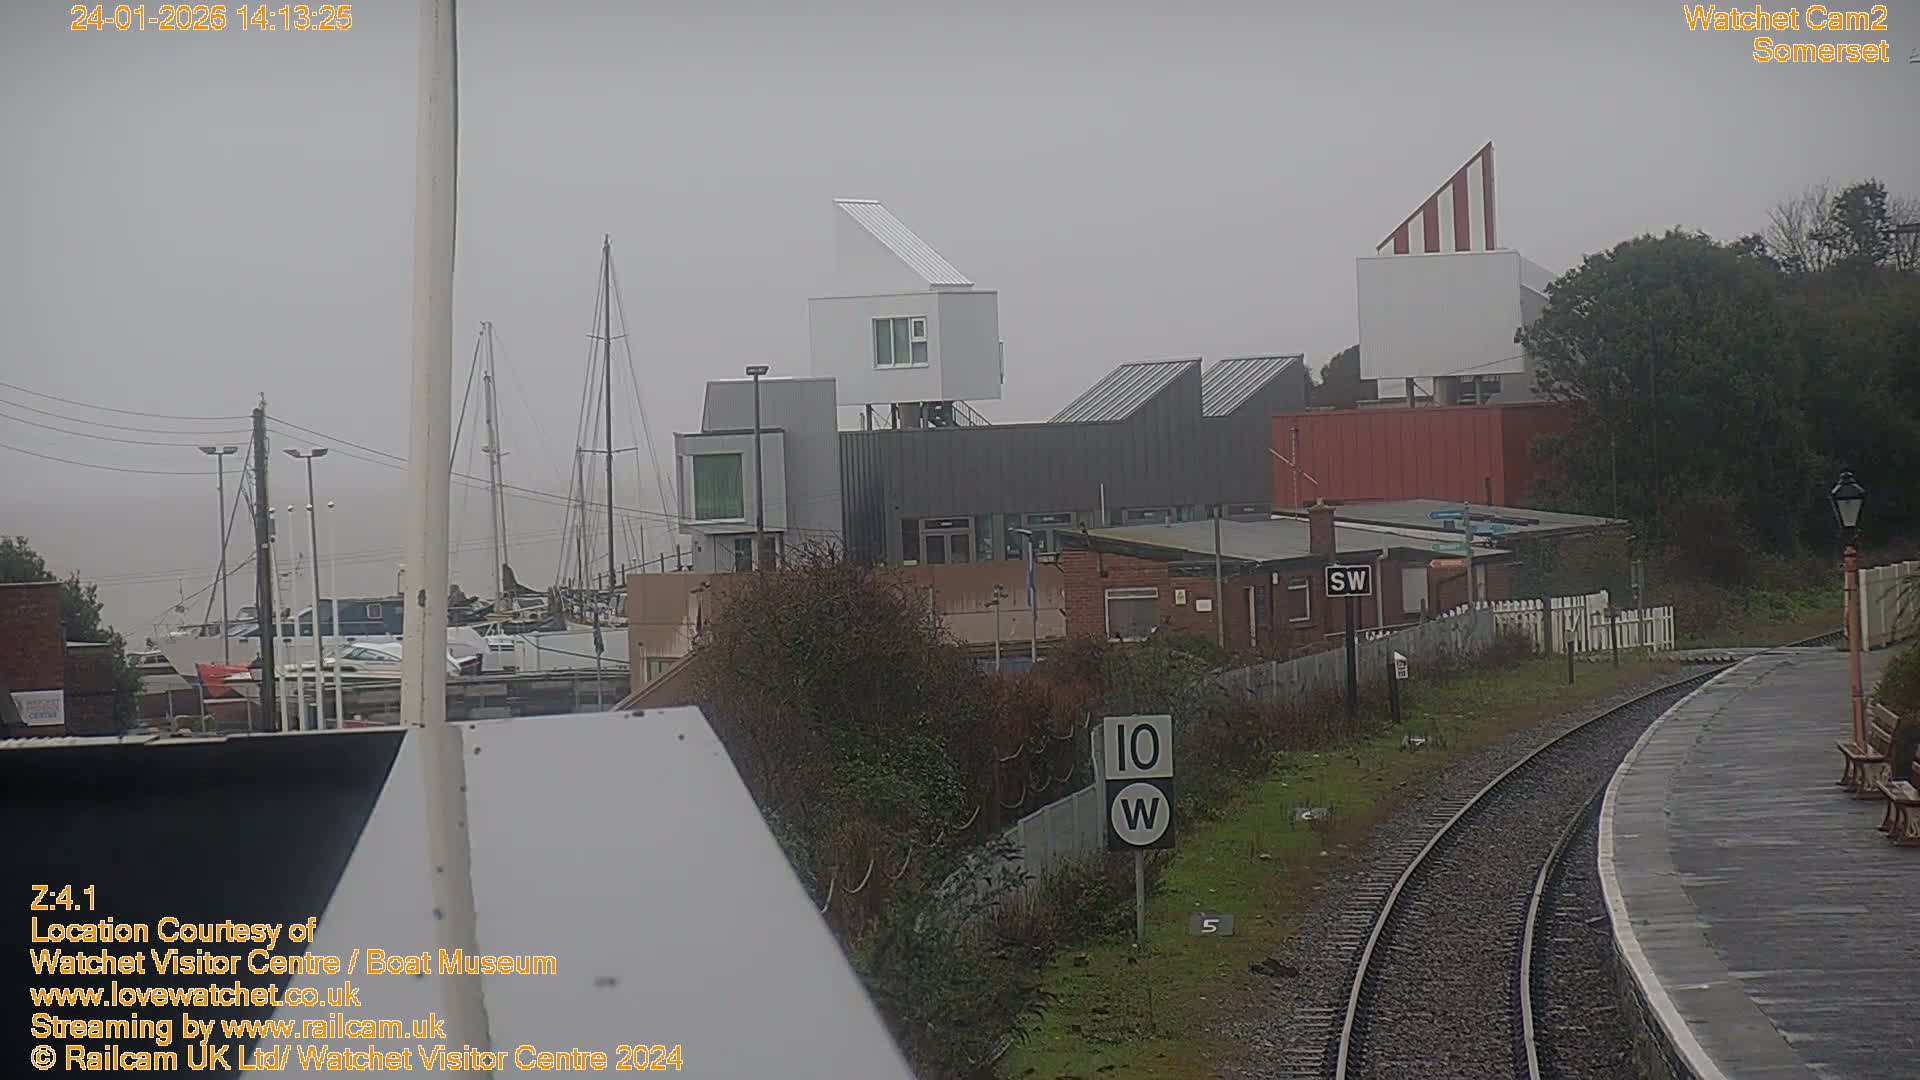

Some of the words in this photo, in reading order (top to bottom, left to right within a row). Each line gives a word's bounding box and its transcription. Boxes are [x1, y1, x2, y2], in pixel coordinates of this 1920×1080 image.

[1330, 570, 1366, 592] SW
[1116, 723, 1160, 772] 10
[1119, 797, 1160, 830] W
[1201, 918, 1220, 933] 5
